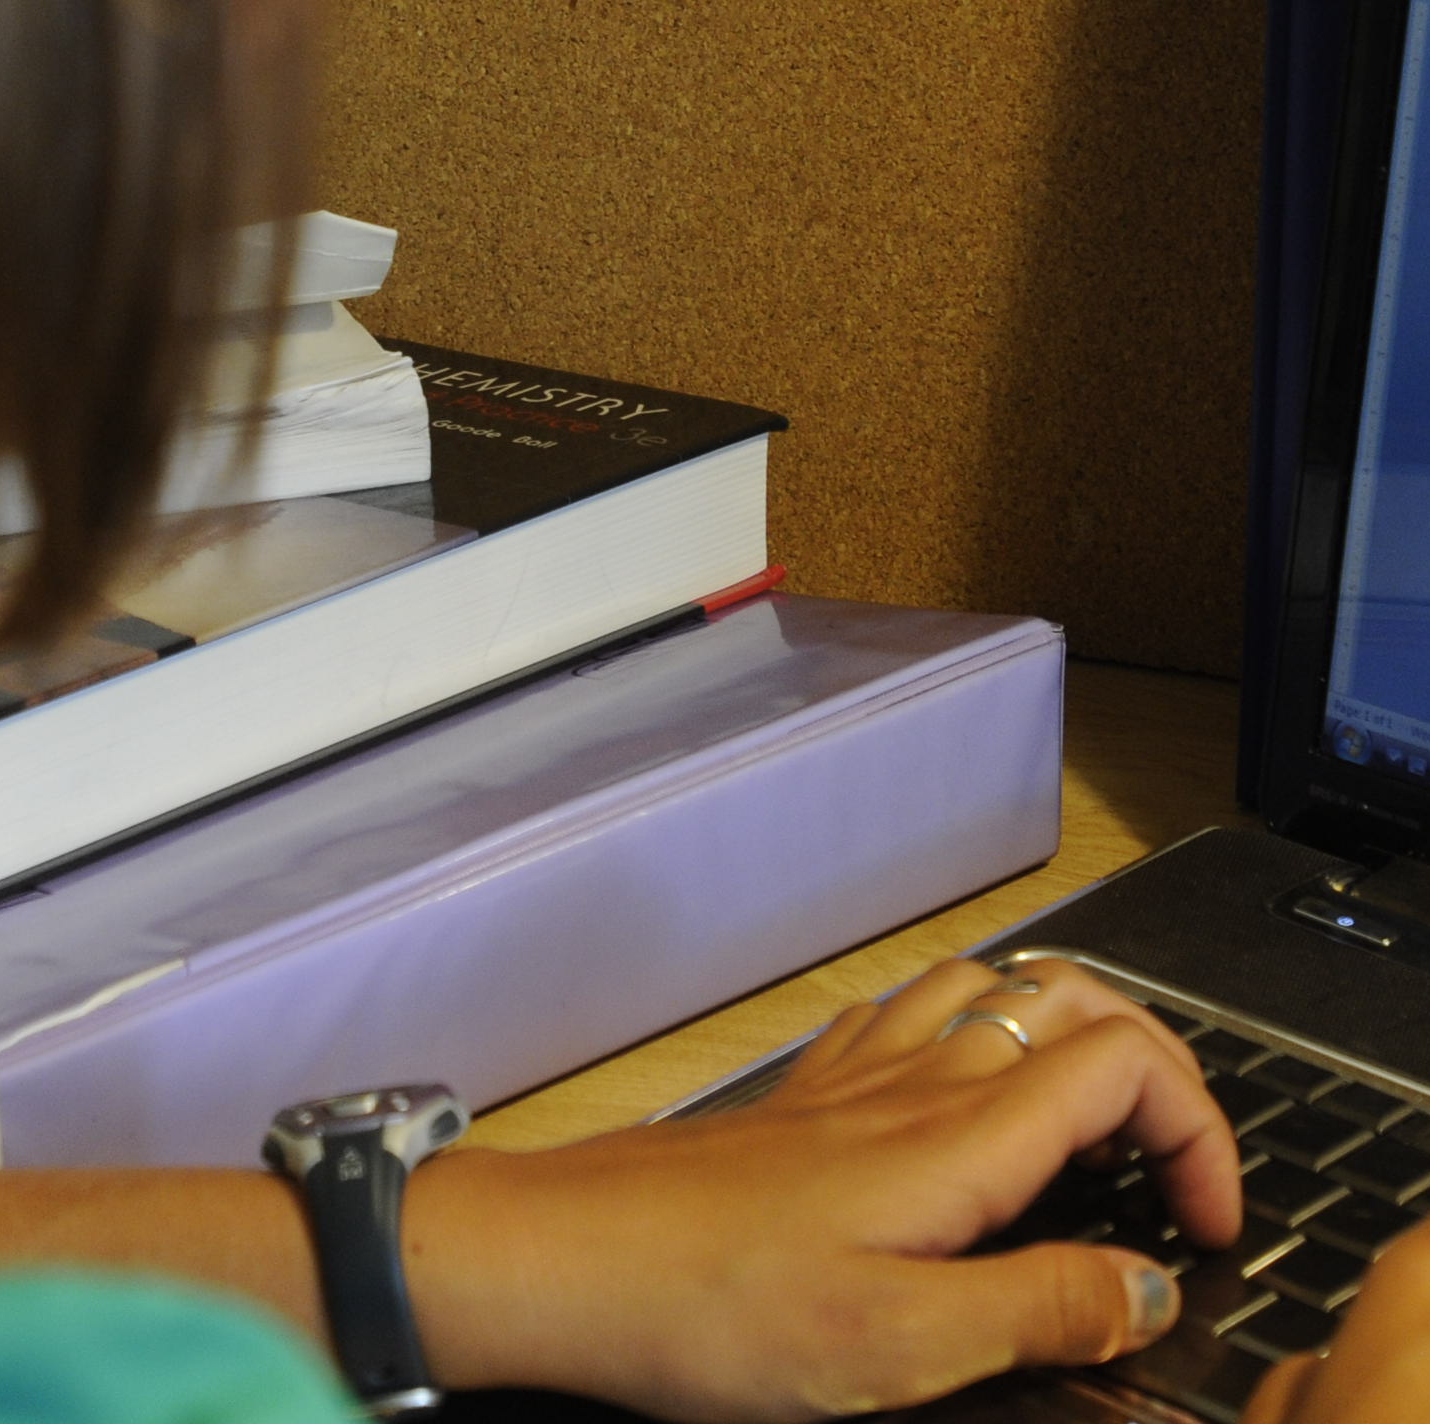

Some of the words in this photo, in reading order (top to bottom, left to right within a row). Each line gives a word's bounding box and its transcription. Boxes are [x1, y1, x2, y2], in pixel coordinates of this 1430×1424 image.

[414, 363, 671, 421] HEMISTRY
[431, 419, 502, 440] Goode
[512, 434, 559, 450] Ball
